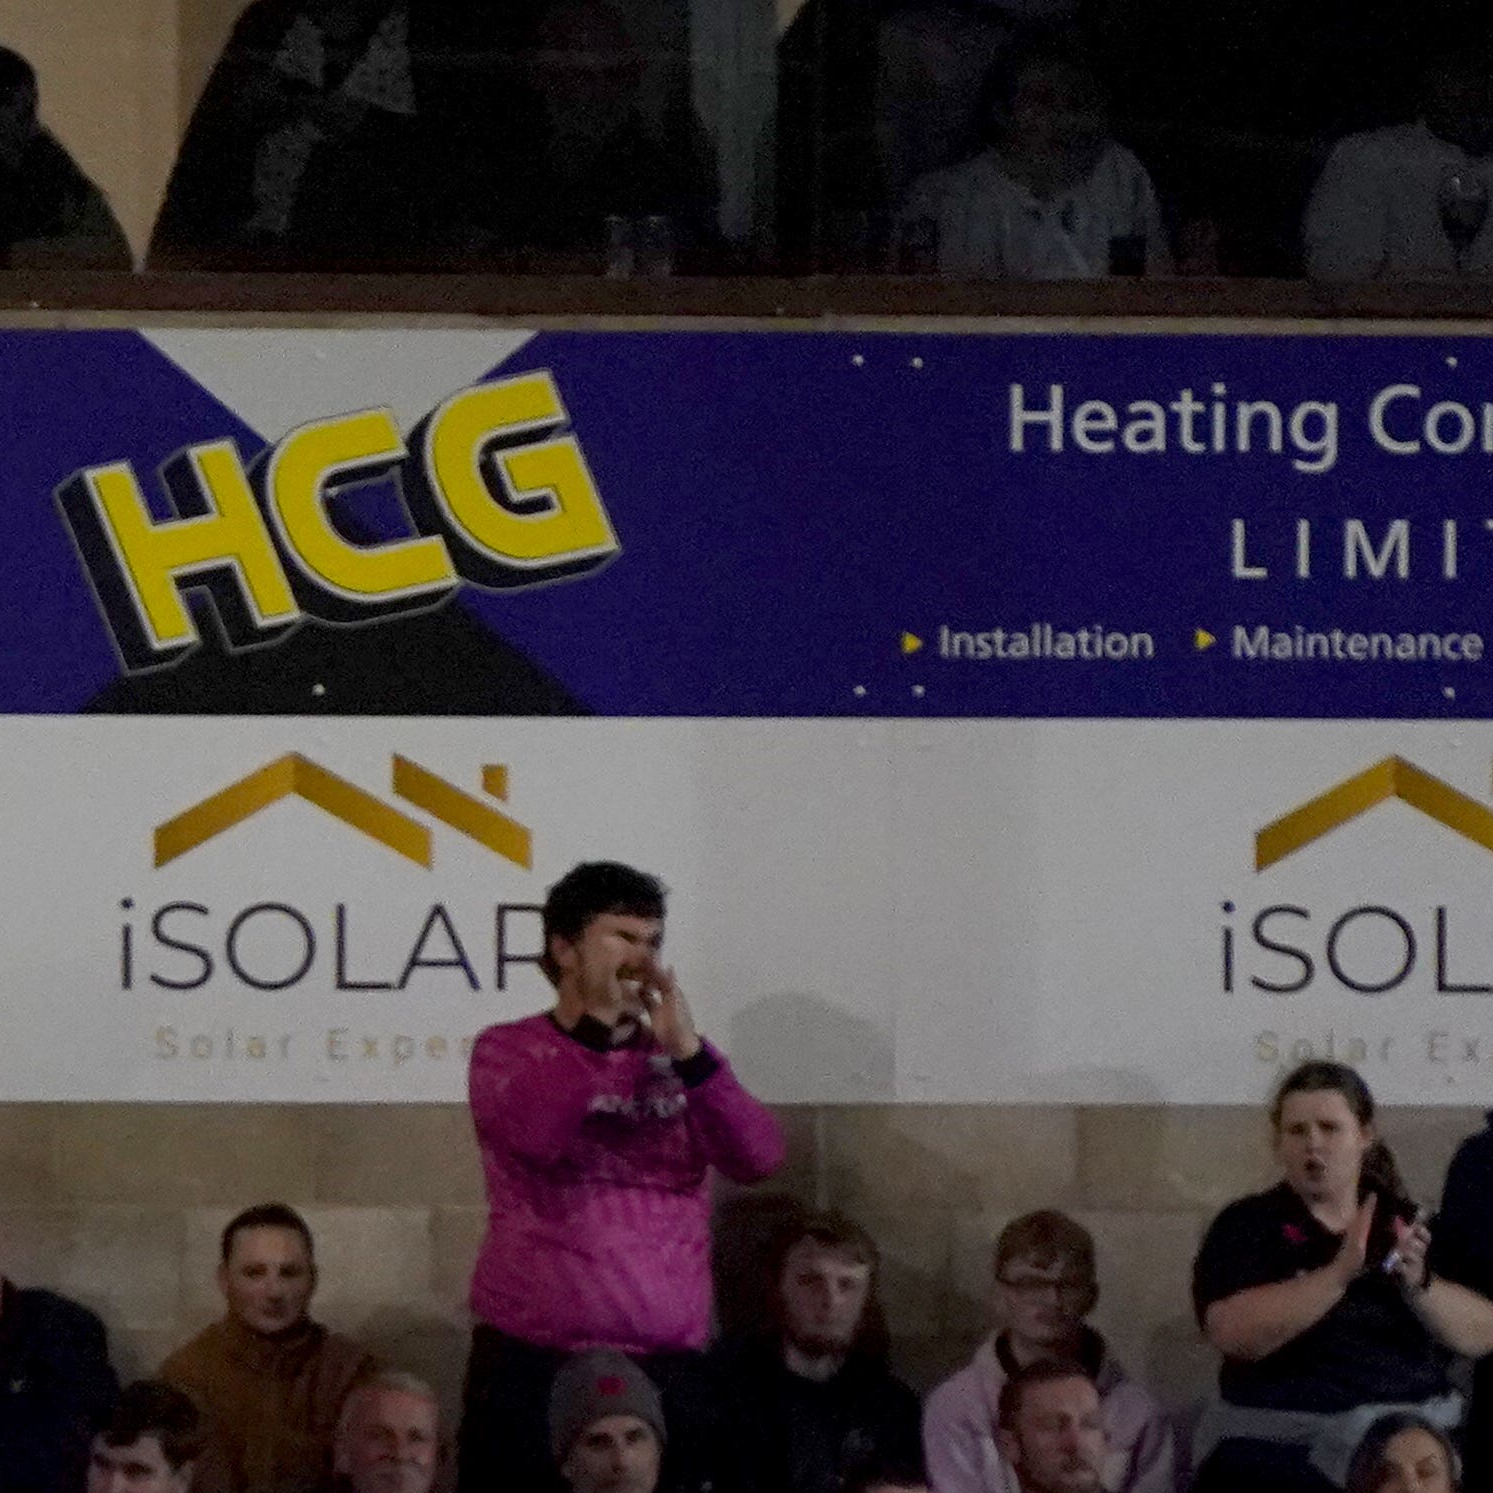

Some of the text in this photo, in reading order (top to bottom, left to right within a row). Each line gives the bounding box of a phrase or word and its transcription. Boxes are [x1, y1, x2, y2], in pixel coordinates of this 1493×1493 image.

[1009, 383, 1338, 473] Heating
[55, 369, 621, 672] HCG
[939, 623, 1155, 660] Installation
[1233, 625, 1484, 661] Maintenance
[154, 1026, 291, 1062] Solar
